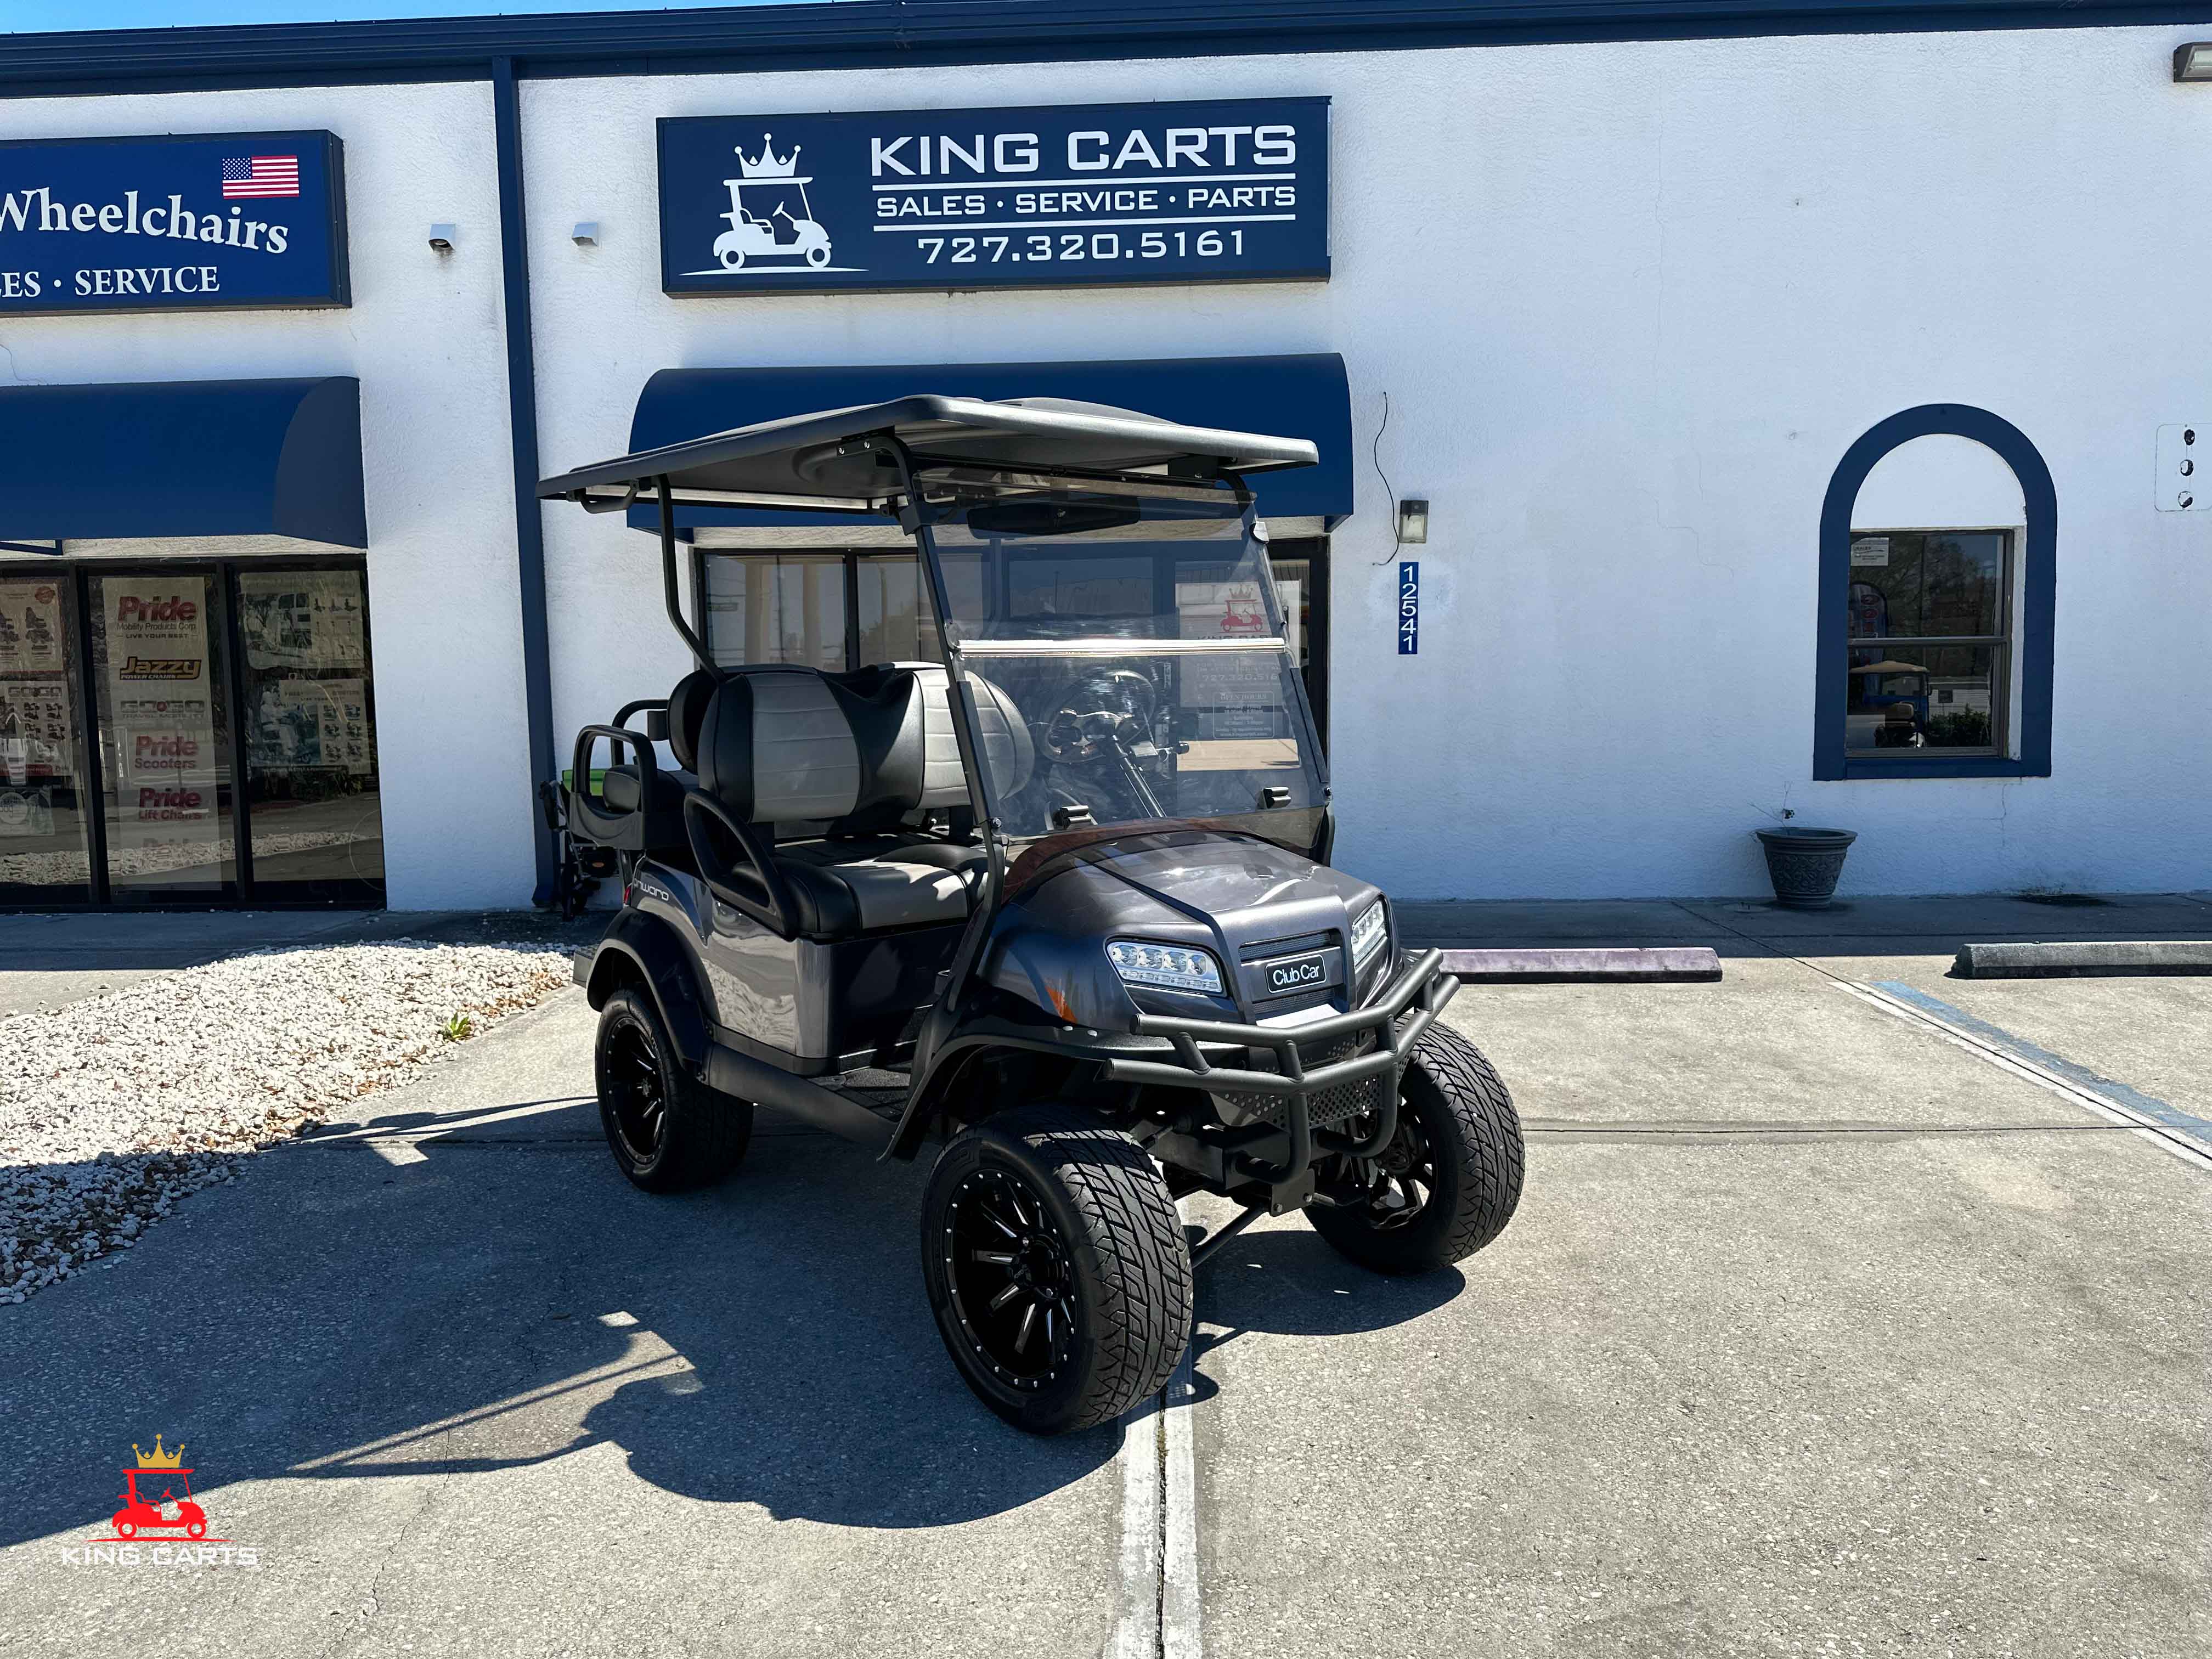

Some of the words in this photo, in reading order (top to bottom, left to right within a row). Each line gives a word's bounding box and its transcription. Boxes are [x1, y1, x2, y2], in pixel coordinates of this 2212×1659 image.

[871, 133, 1039, 176] KING
[1068, 125, 1296, 171] CARTS
[877, 195, 985, 217] SALES
[1015, 190, 1158, 213] SERVICE
[1188, 186, 1295, 208] PARTS
[0, 187, 289, 254] Wheelchairs
[918, 230, 1242, 264] 727.320.5161
[0, 272, 41, 298] ES
[75, 266, 220, 296] SERVICE
[118, 596, 197, 622] Pride
[1401, 566, 1417, 652] 12541
[117, 623, 144, 631] Mobility
[120, 657, 202, 680] Jazzy
[136, 736, 199, 757] Pride
[135, 758, 196, 769] Scooters
[139, 788, 202, 808] Pride
[139, 809, 159, 821] Lift
[1273, 967, 1300, 985] Club
[1300, 964, 1320, 980] Car
